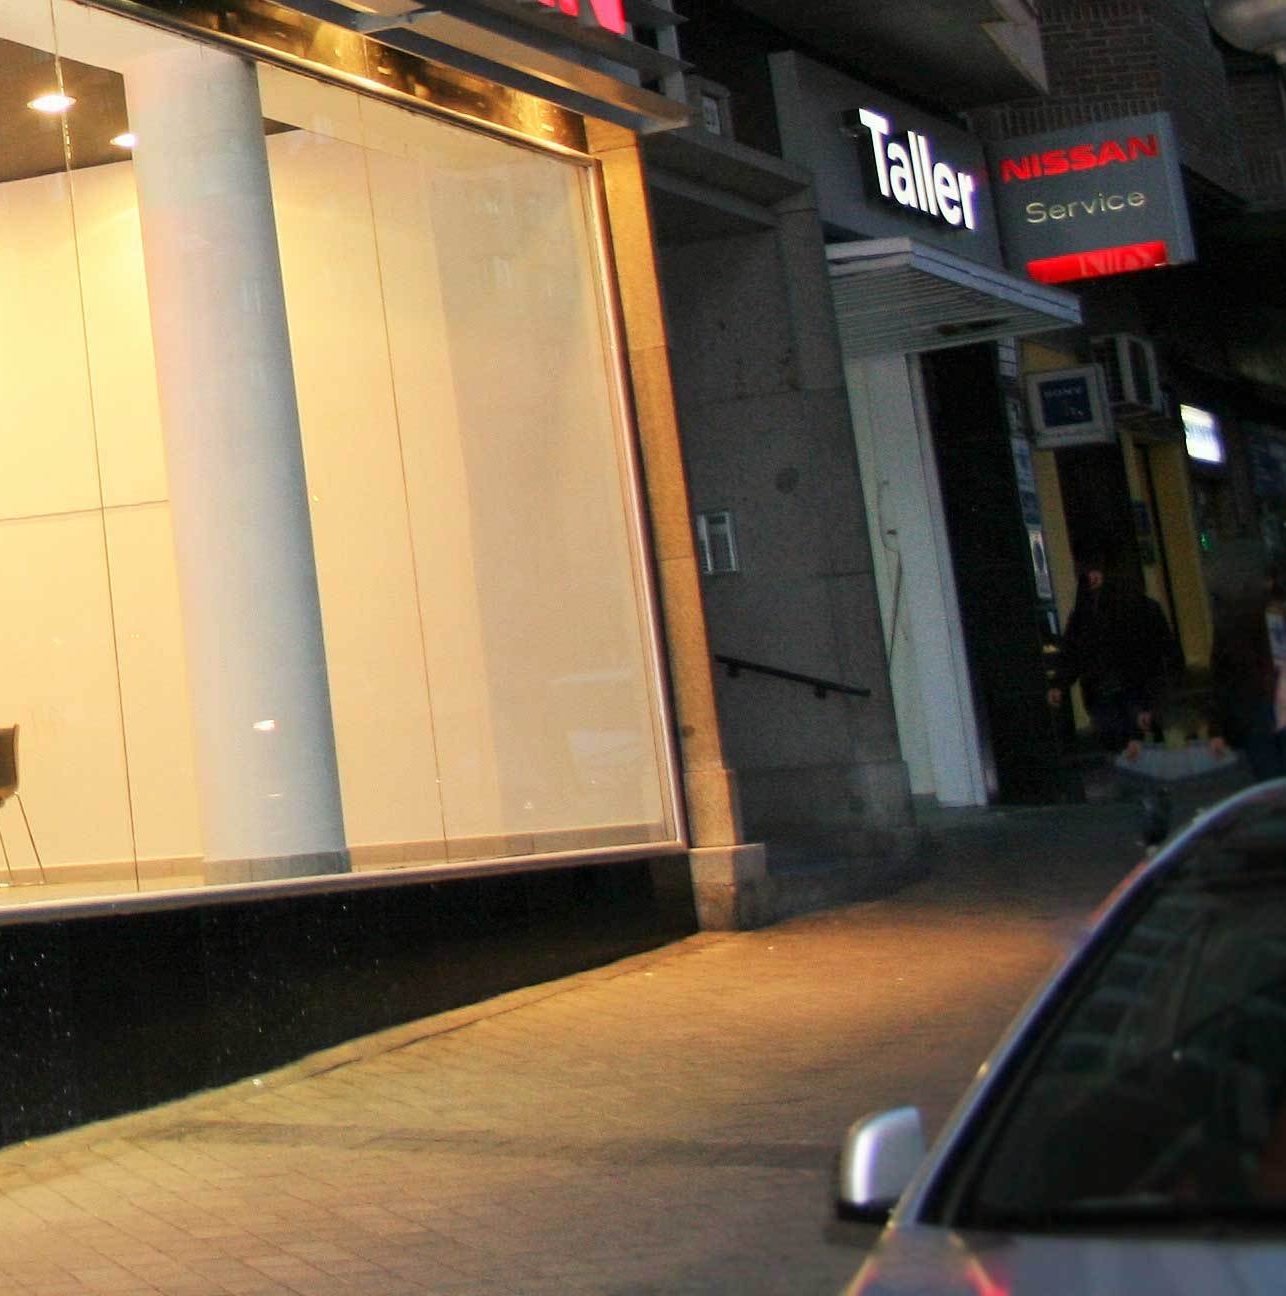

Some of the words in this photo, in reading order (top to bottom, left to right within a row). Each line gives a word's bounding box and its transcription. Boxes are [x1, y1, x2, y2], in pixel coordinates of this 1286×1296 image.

[858, 107, 976, 230] Taller
[999, 133, 1159, 184] NISSAN
[1026, 191, 1145, 224] Service
